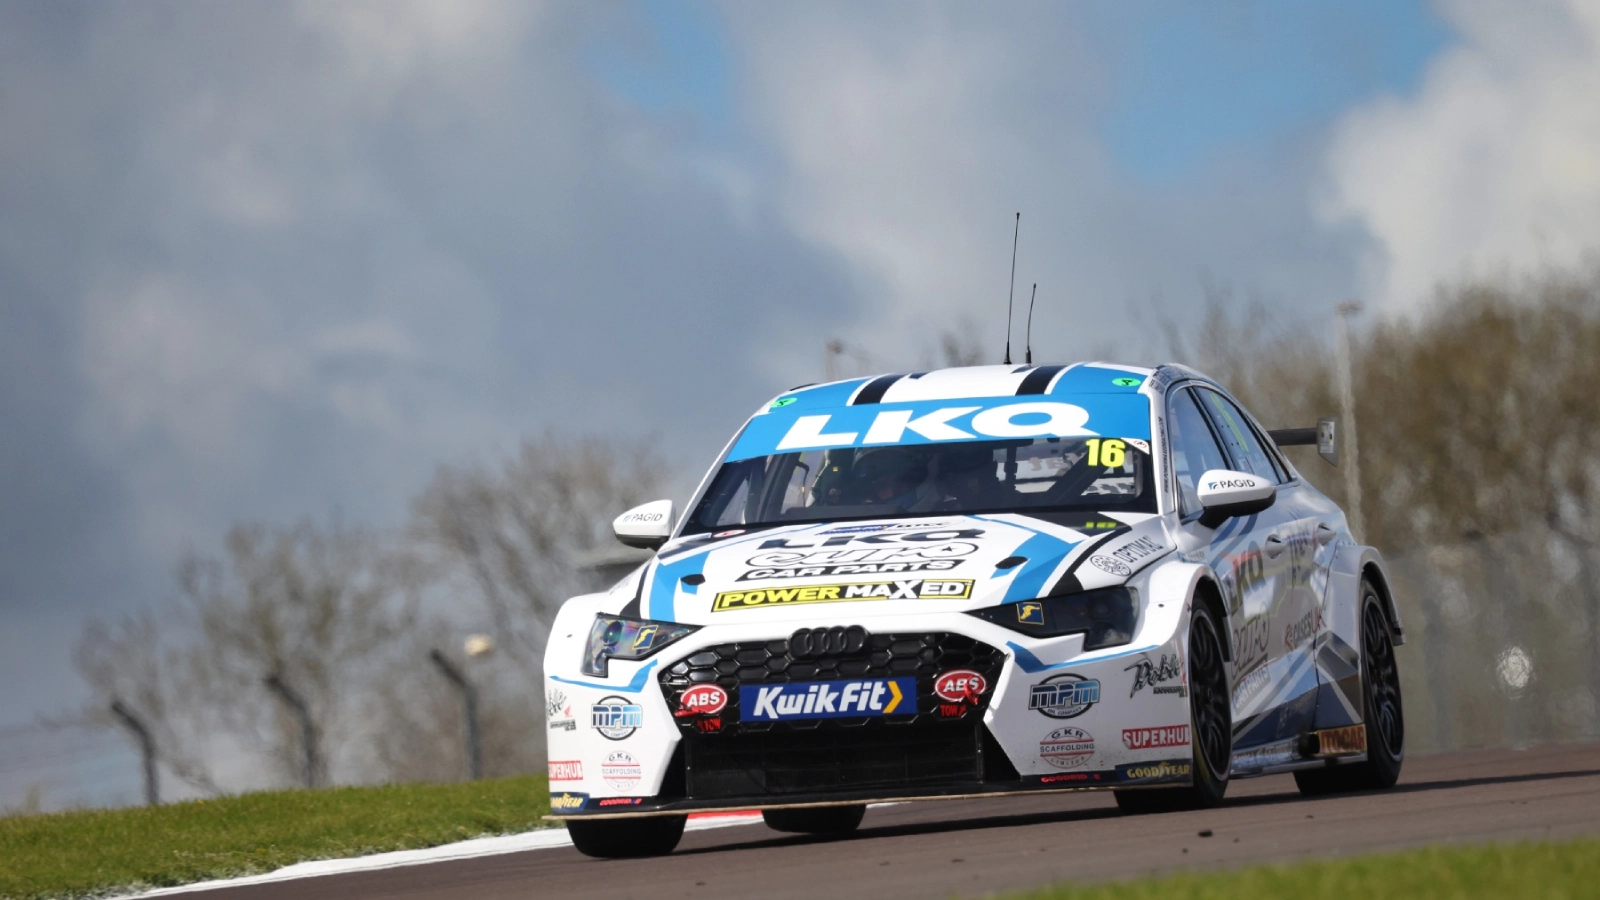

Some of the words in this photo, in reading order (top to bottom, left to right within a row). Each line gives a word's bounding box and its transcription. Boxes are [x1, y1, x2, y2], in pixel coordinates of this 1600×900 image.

[776, 402, 1100, 450] LKQ
[1086, 438, 1126, 468] 16
[1219, 479, 1256, 489] PAGID
[631, 513, 663, 522] PAGID
[757, 530, 986, 550] LKQ
[1112, 535, 1164, 564] OPTIMAL
[747, 566, 801, 580] CAR
[831, 559, 955, 576] PARTS
[720, 586, 841, 607] POWER
[845, 579, 966, 600] MAXED
[942, 676, 980, 693] ABS
[686, 691, 721, 707] ABS
[940, 704, 958, 717] TOW
[1057, 706, 1082, 716] COMPANY
[1051, 728, 1084, 740] GKR
[1040, 742, 1095, 753] SCAFFOLDING
[608, 752, 632, 763] GKR
[1050, 755, 1085, 766] LIMITED
[601, 767, 642, 775] SCAFFOLDING
[1127, 762, 1190, 778] GOODYEAR
[1041, 773, 1101, 783] GOODRIDE
